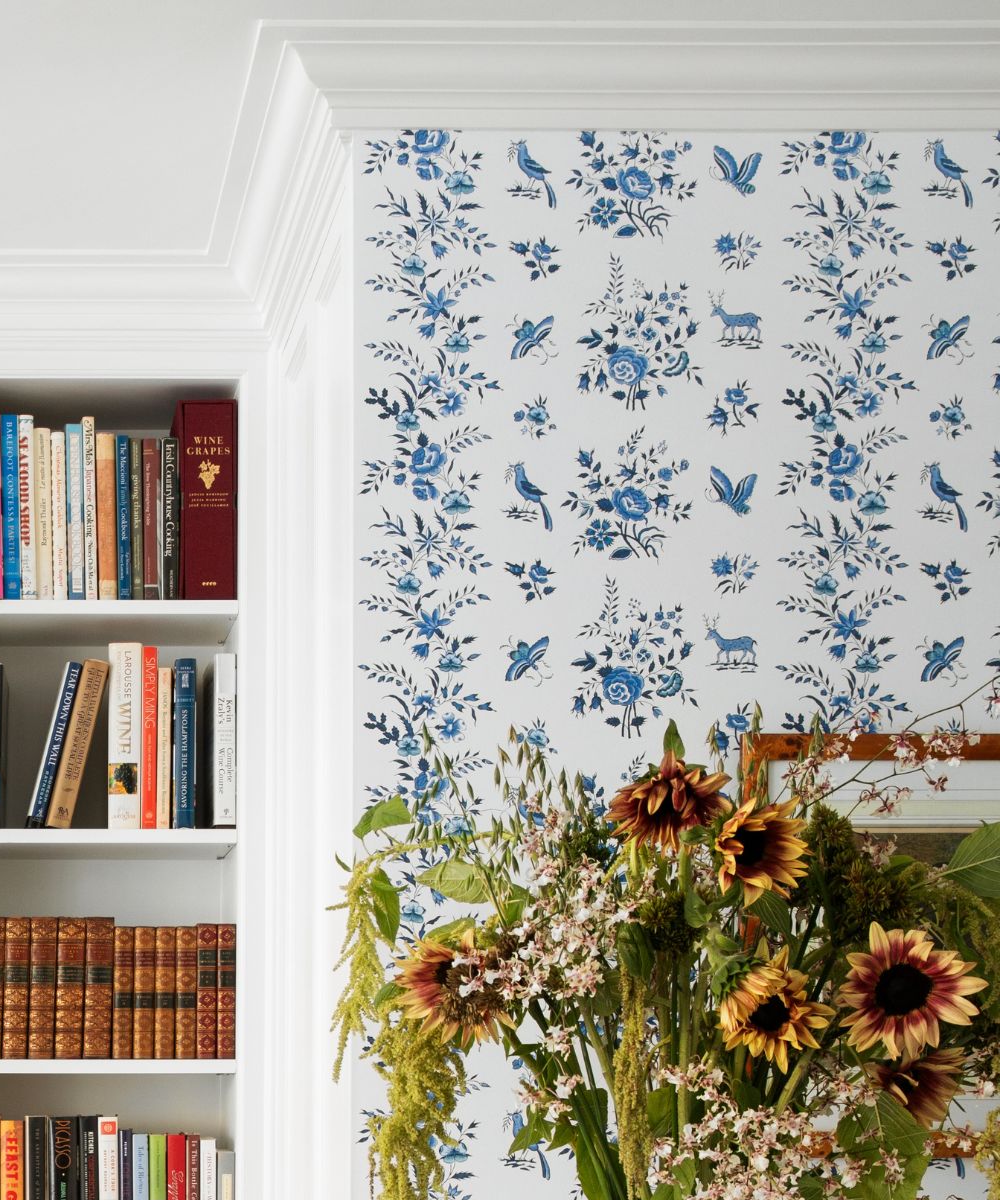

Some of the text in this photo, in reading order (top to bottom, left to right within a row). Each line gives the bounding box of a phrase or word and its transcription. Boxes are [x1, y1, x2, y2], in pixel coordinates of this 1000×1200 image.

[6, 421, 14, 471] BAREFOOT
[186, 447, 231, 456] GRAPES
[194, 436, 224, 445] WINE
[19, 436, 30, 503] SEAFOOD
[132, 474, 142, 500] giving
[85, 469, 95, 538] Japanese Cooking
[119, 487, 128, 507] Family
[134, 502, 142, 529] thanks
[164, 444, 175, 557] Irish Countryhouse Cooking
[8, 525, 16, 564] PARTIES!
[20, 506, 31, 547] SHOP
[121, 508, 129, 541] Cookbook
[117, 650, 132, 755] LAROUSSE WINE
[145, 657, 156, 729] SIMPLY MING
[47, 668, 80, 767] TEAR DOWN THIS WALL
[75, 710, 87, 735] GREAT
[64, 762, 74, 780] LIFE
[226, 747, 234, 783] Complete
[5, 1136, 18, 1181] FEAST
[55, 1120, 72, 1169] PICASSO
